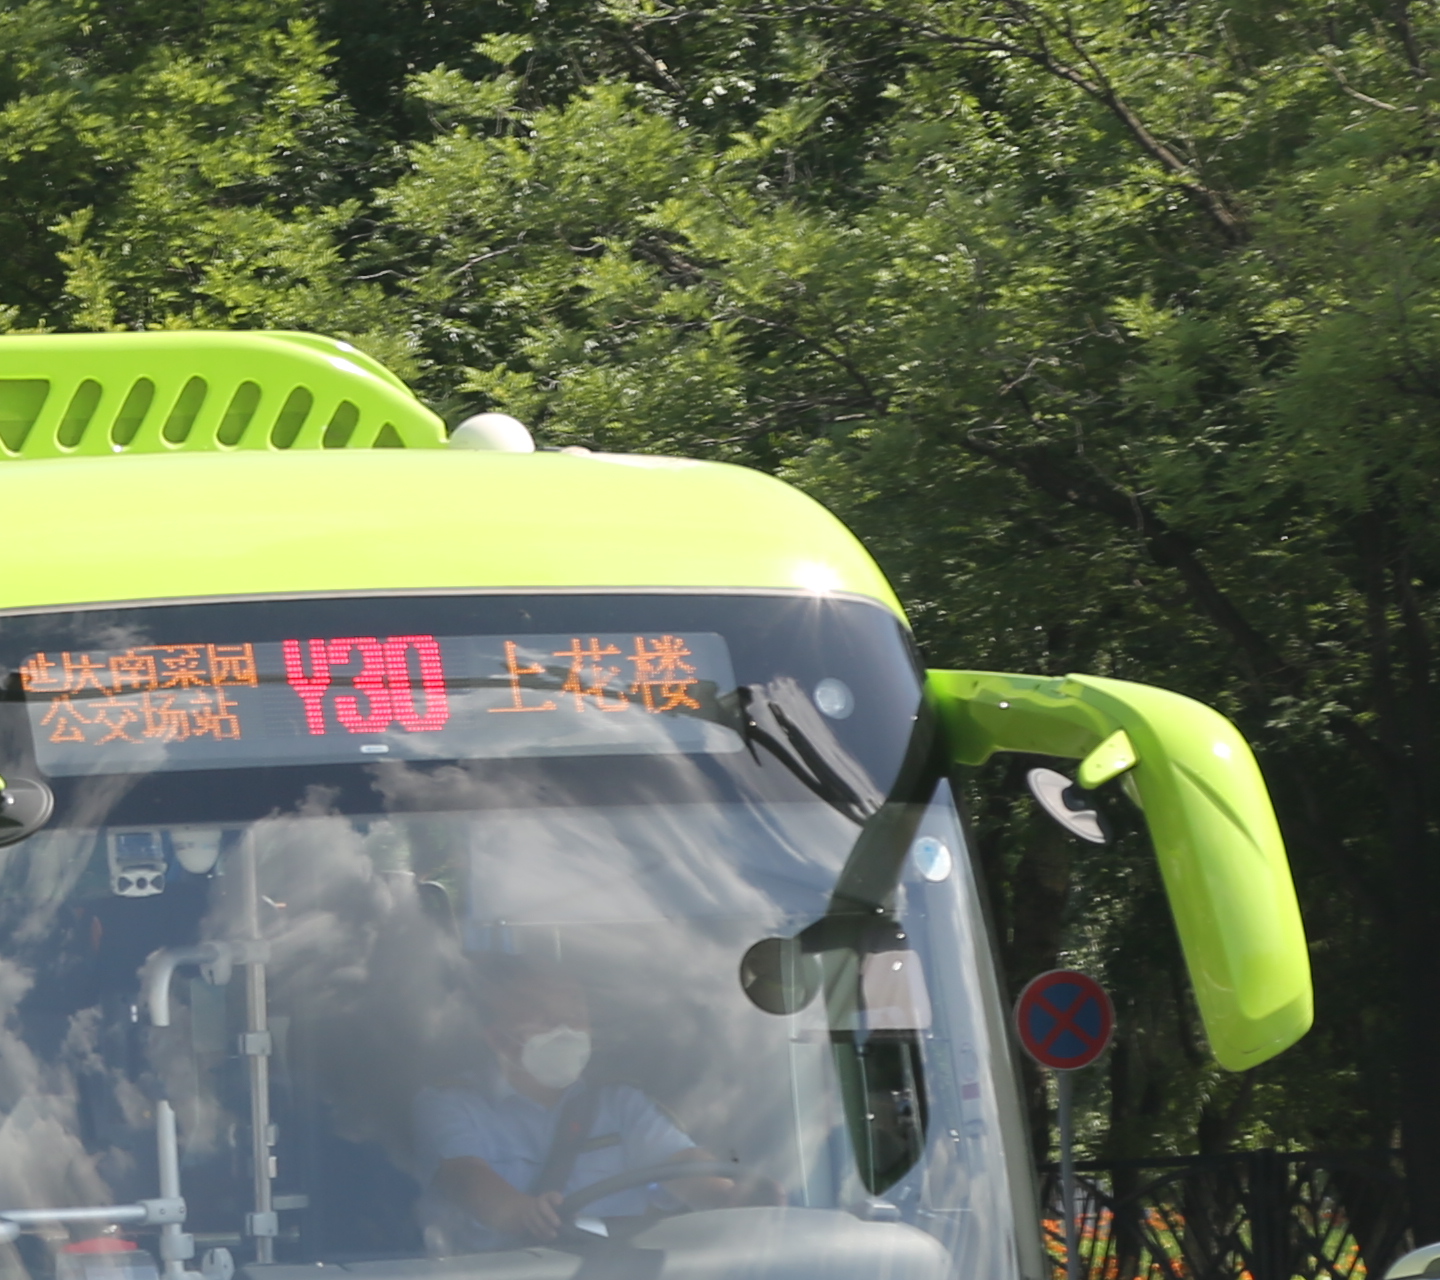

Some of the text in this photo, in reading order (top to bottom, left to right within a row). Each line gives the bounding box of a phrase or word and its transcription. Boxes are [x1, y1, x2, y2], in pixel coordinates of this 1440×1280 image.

[282, 635, 450, 735] Y30
[487, 635, 701, 714] 上花楼
[40, 687, 241, 745] 公交场站
